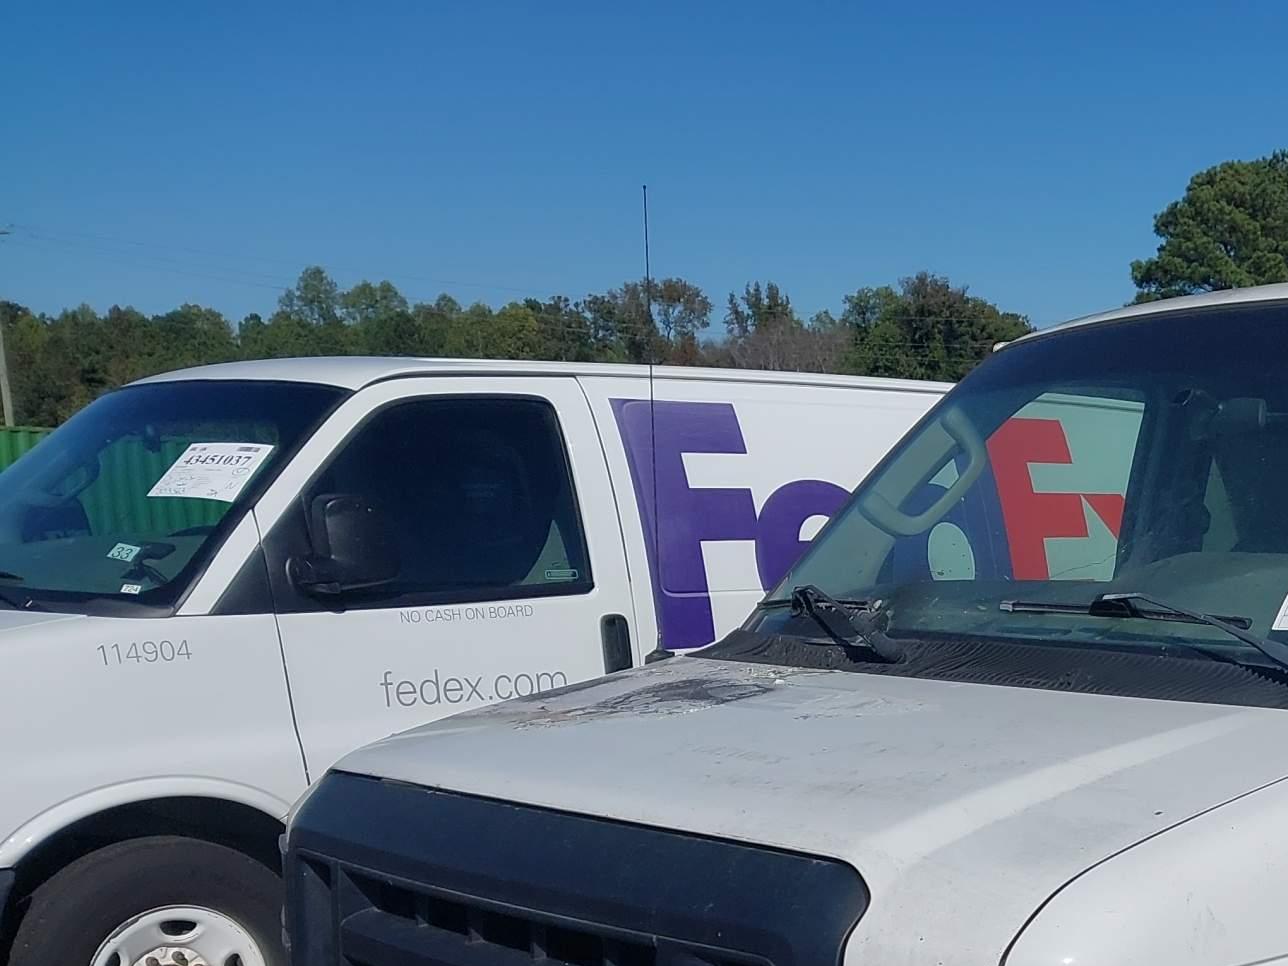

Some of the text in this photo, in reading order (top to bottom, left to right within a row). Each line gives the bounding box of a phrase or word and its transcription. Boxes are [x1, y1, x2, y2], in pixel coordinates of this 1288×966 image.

[183, 454, 253, 466] 43451037
[111, 546, 133, 560] 33
[400, 604, 534, 624] NO CASH ON BOARD
[97, 640, 193, 666] 114904
[379, 669, 568, 708] fedex.com
